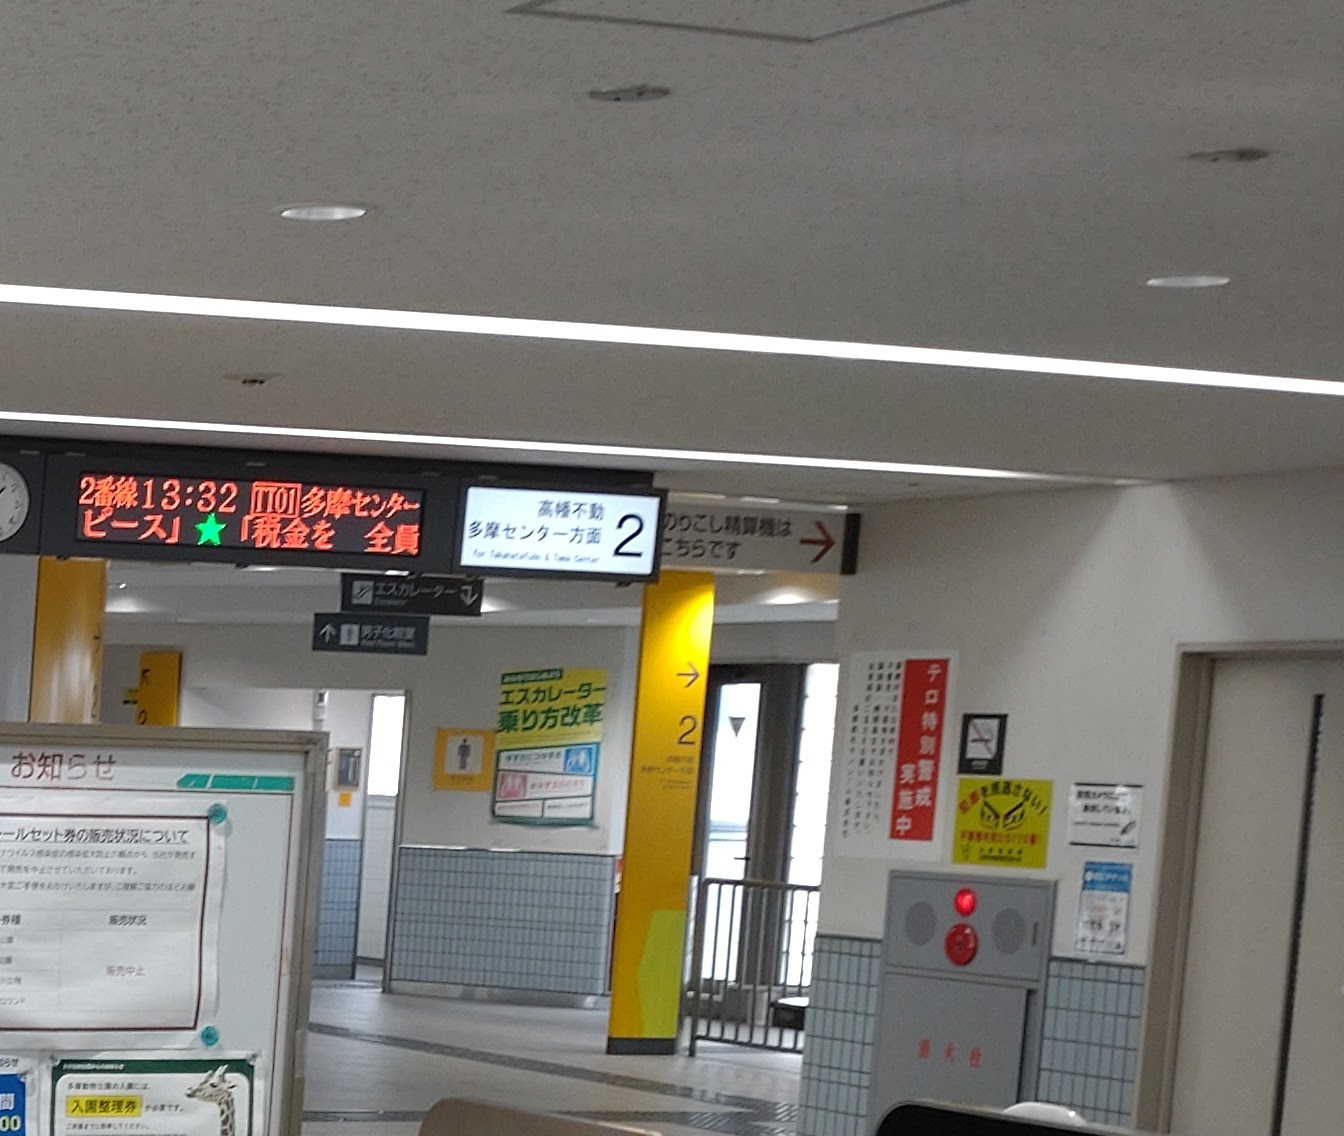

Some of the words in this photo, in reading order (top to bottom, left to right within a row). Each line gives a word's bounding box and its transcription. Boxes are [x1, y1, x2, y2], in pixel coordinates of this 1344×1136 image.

[143, 478, 238, 513] 13:32
[301, 486, 420, 520] 多摩センター
[537, 500, 605, 521] 高幡不動
[364, 521, 420, 556] 全員
[467, 520, 603, 544] 多摩センター方面
[612, 514, 645, 558] 2
[374, 581, 457, 599] エスカレーター
[499, 682, 607, 706] エスカレーター
[497, 702, 604, 734] 乗り方改革
[677, 715, 698, 746] 2
[11, 751, 117, 781] お知らせ
[71, 1099, 138, 1114] 入園整理券
